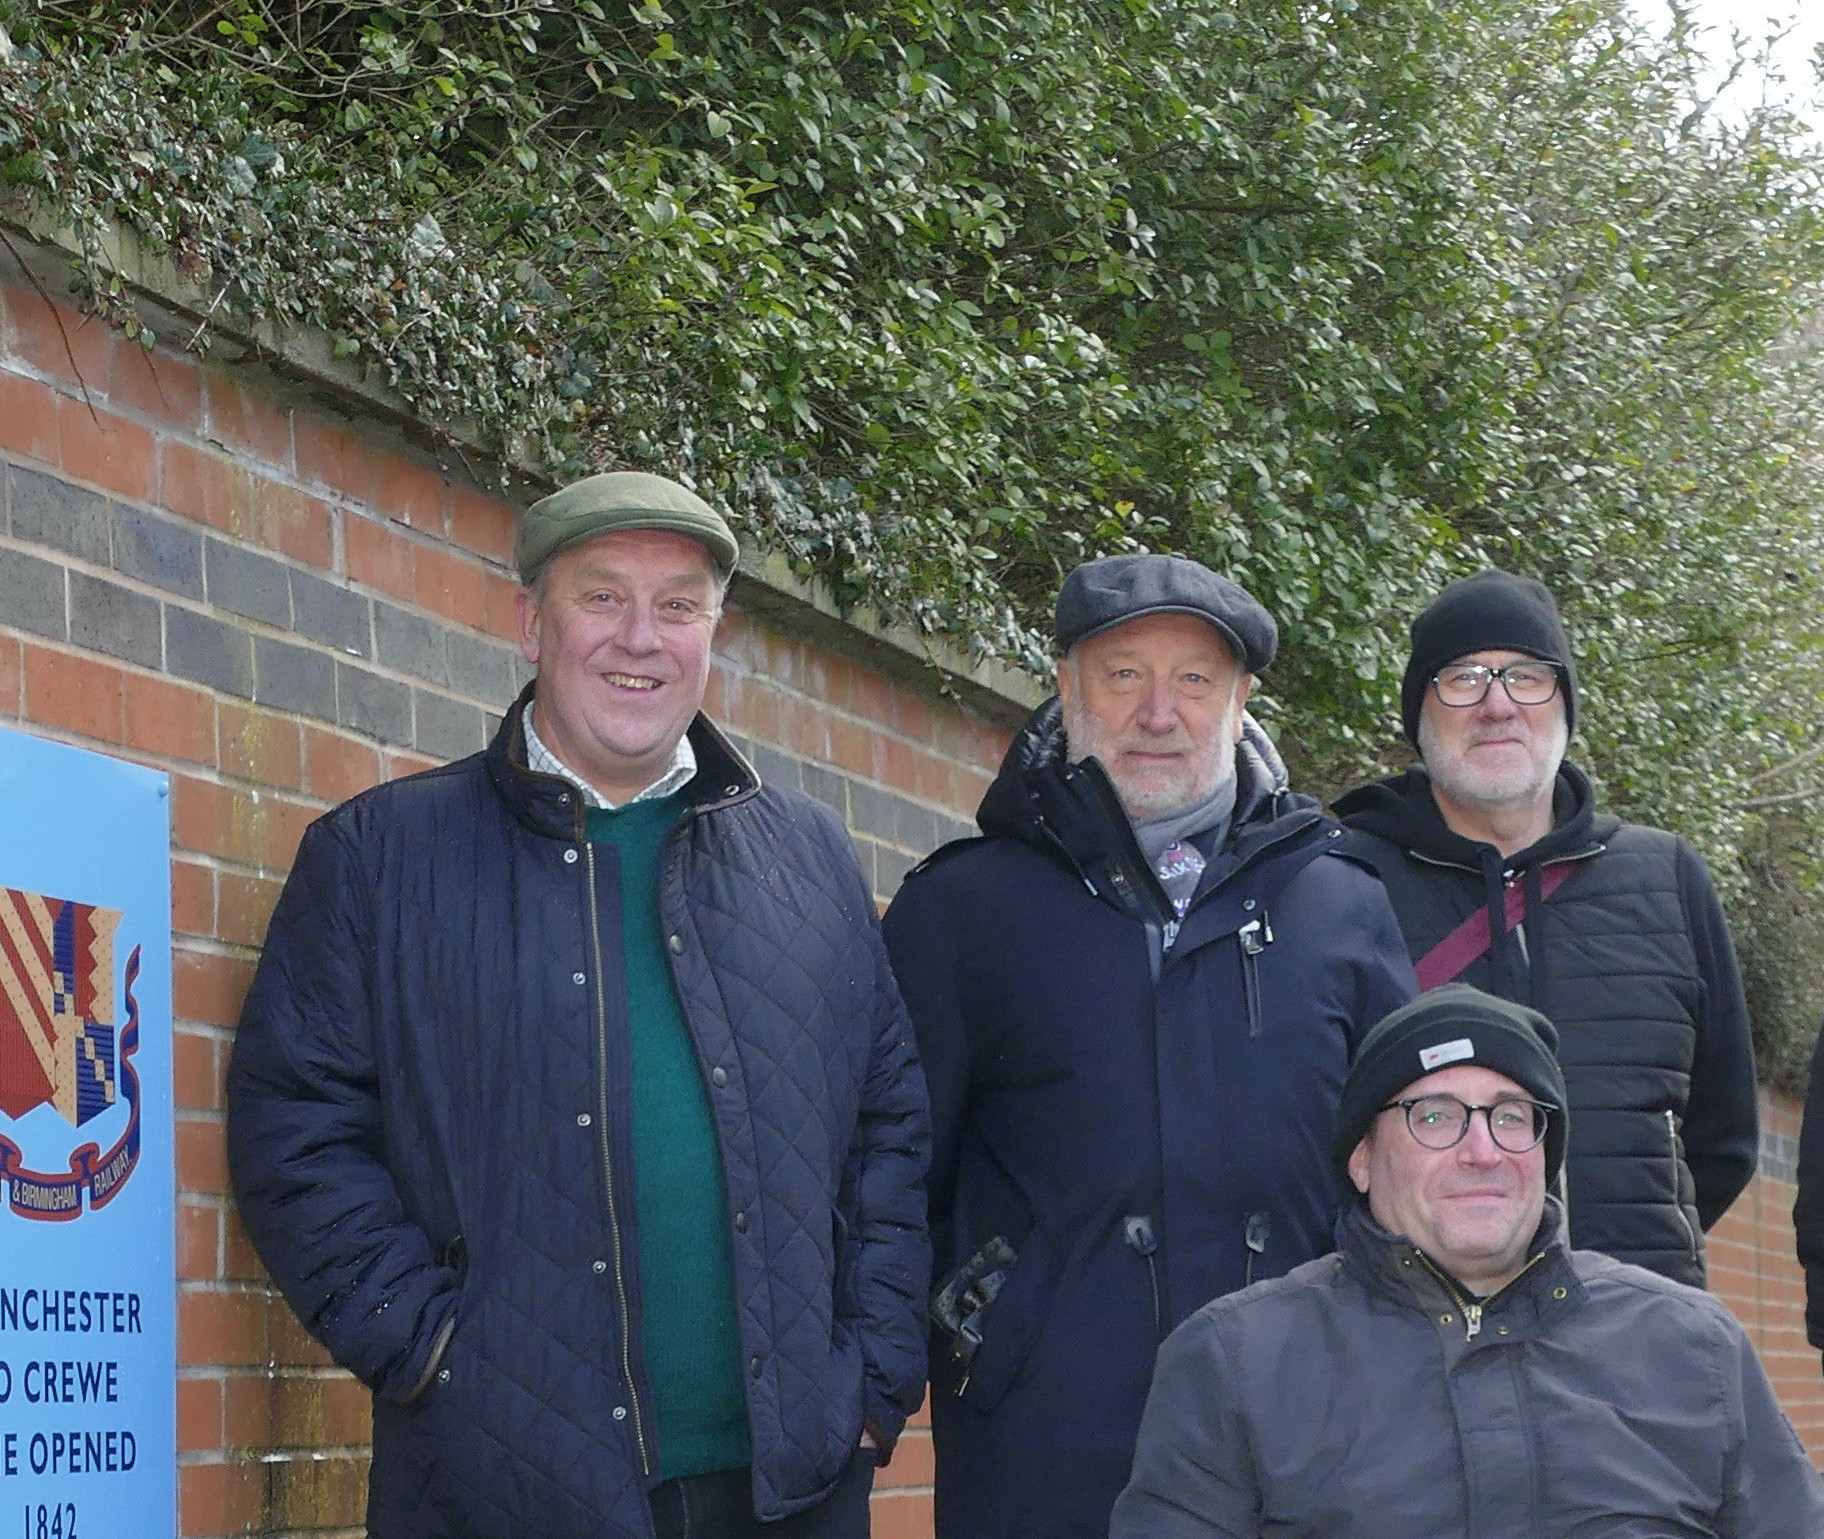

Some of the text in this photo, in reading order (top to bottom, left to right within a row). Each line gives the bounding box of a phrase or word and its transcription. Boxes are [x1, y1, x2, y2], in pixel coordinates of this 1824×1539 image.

[12, 1179, 20, 1202] &
[22, 1182, 76, 1210] BIRMINGHAM
[24, 1361, 118, 1403] CREWE
[30, 1432, 136, 1474] OPENED
